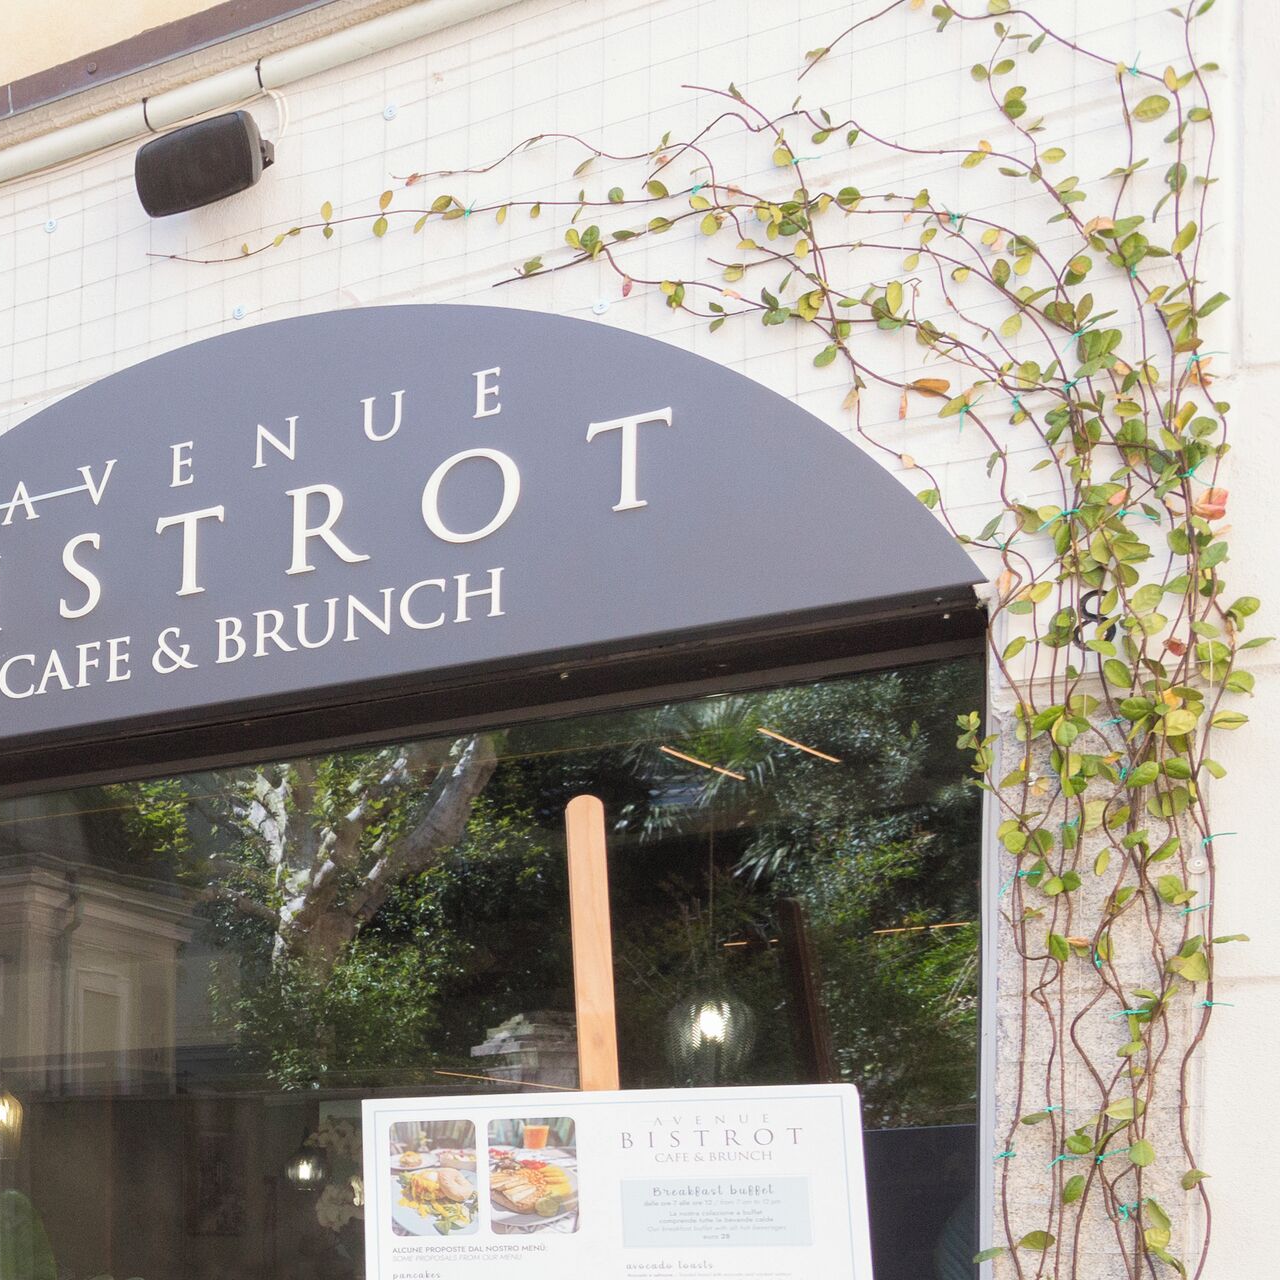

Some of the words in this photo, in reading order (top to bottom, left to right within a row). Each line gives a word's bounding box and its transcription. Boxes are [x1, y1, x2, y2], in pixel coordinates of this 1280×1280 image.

[151, 626, 199, 675] &
[214, 566, 508, 666] BRUNCH
[650, 1113, 770, 1127] AVENUE
[621, 1127, 804, 1149] BISTROT
[654, 1152, 690, 1164] CAFE
[693, 1151, 706, 1163] &
[709, 1150, 773, 1162] BRUNCH
[652, 1184, 724, 1197] Breakfast
[729, 1184, 775, 1197] buffet
[392, 1246, 423, 1254] ALCUNE
[425, 1246, 466, 1254] PROPOSTE
[468, 1245, 484, 1253] DAL
[485, 1244, 520, 1252] NOSTRO
[626, 1260, 673, 1271] avocado
[677, 1259, 713, 1270] toasts
[392, 1270, 441, 1280] pancakes
